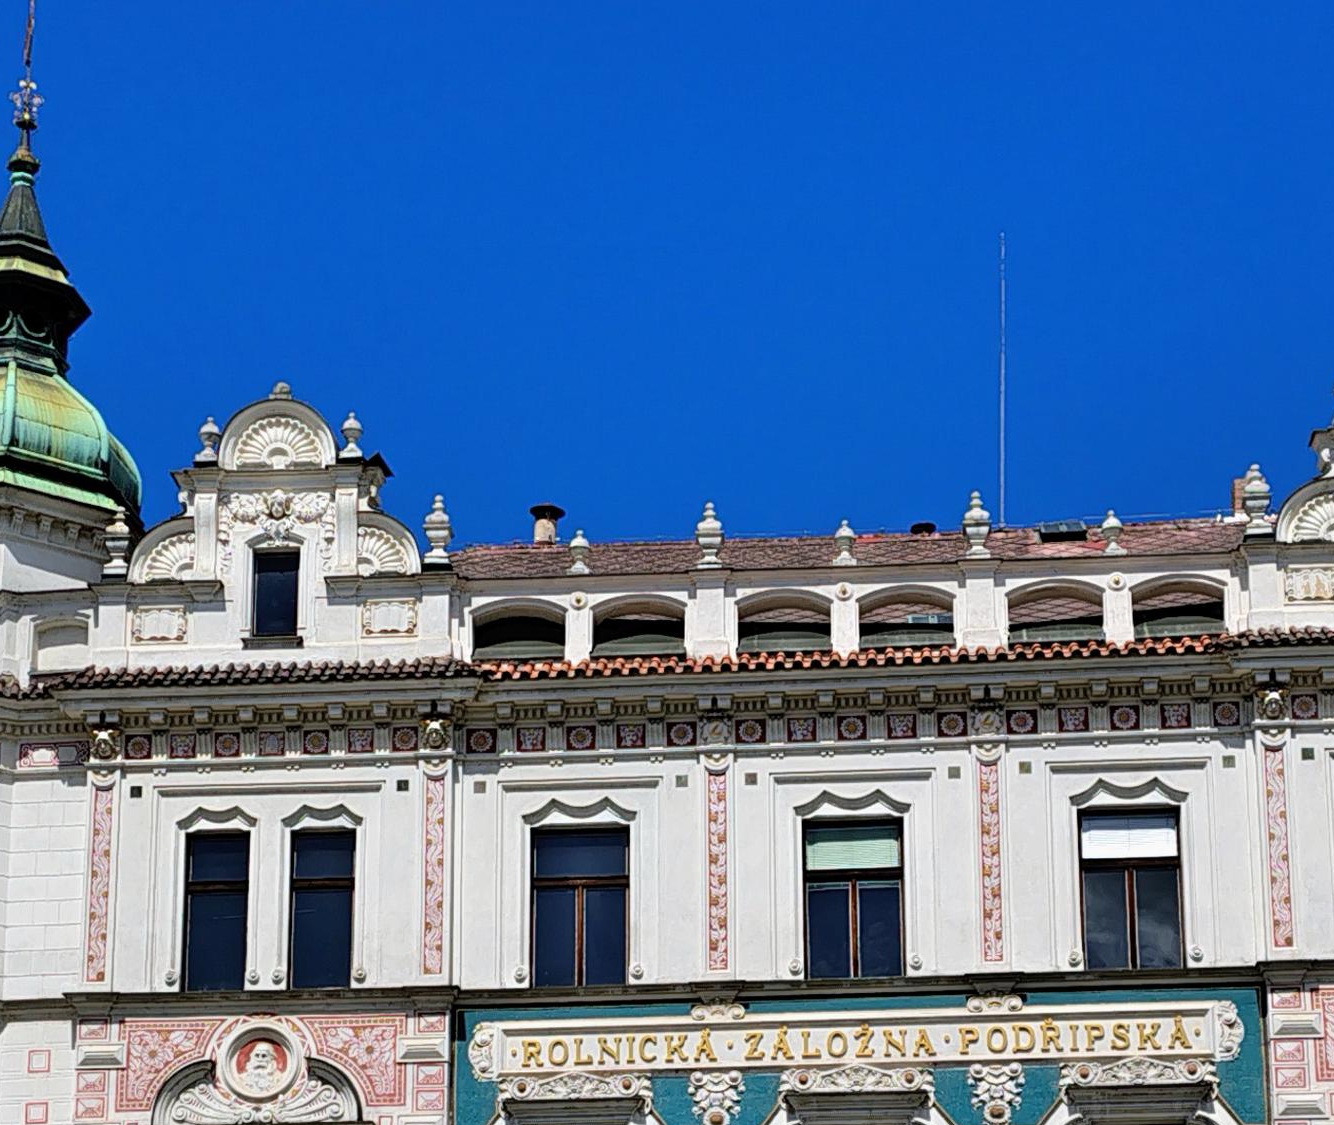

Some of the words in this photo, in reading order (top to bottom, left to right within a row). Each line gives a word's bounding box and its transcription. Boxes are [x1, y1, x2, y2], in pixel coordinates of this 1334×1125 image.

[521, 1027, 718, 1067] ROLNICKÁ
[744, 1023, 937, 1061] ZÁLOŽNA
[958, 1015, 1194, 1055] PODŘIPSKÁ
